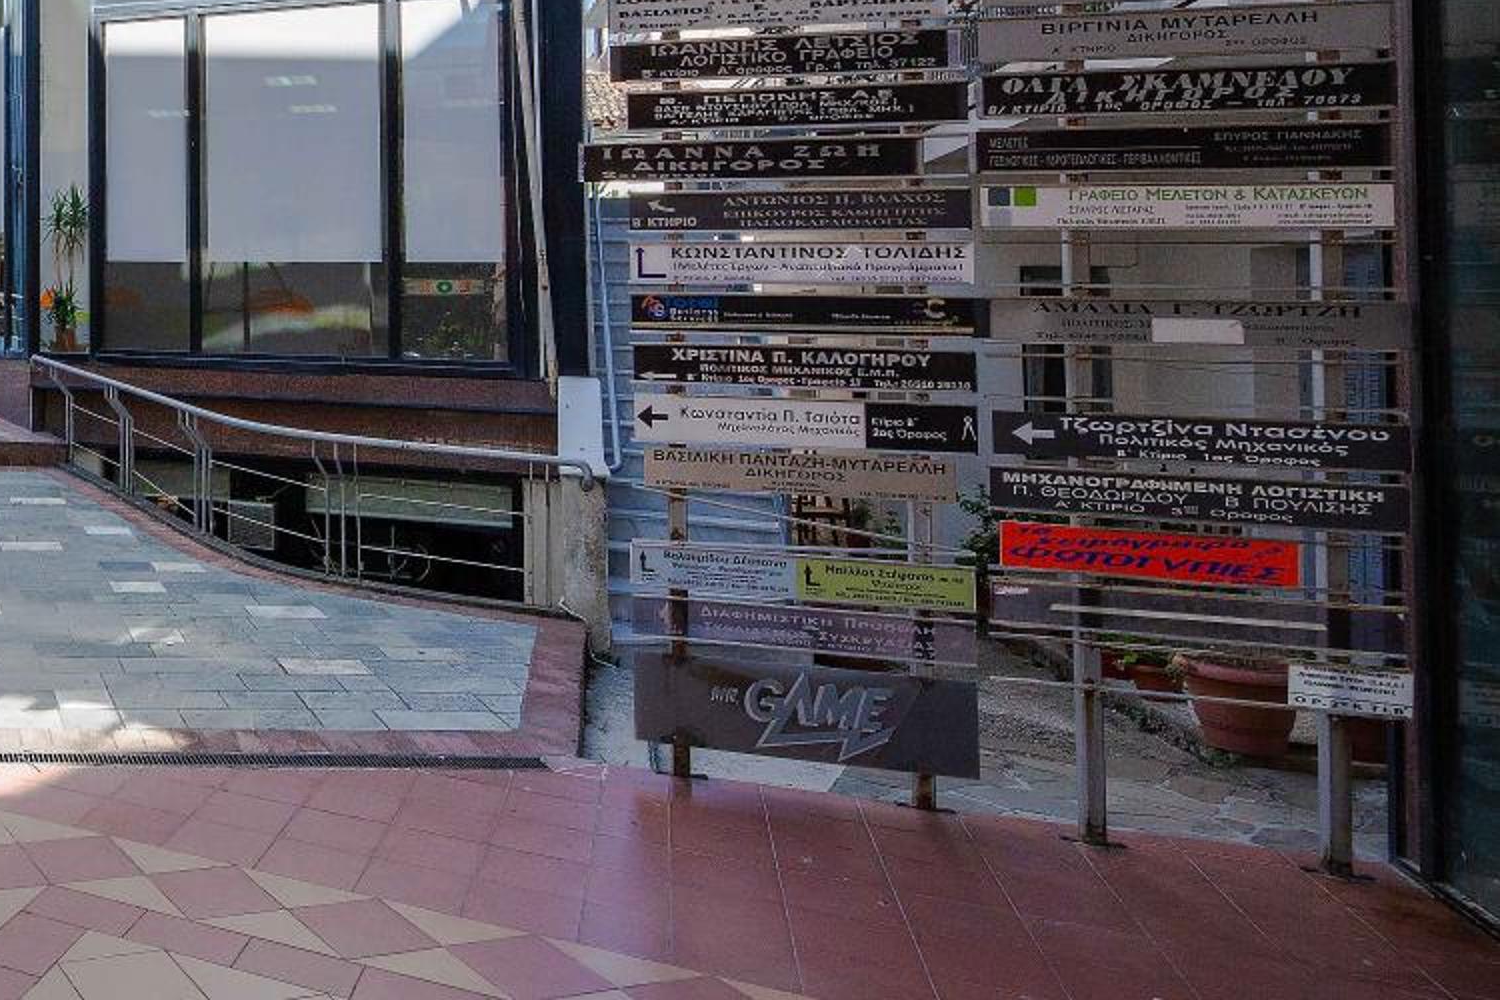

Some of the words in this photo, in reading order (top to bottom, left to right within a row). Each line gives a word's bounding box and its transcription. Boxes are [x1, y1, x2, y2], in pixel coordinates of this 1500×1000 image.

[1041, 18, 1149, 35] ΒΙΡΓΙΝΙΑ
[1161, 11, 1318, 30] ΜΥΤΑΡΕΛΛΗ
[650, 40, 779, 57] ΙΩΑΝΝΗΣ
[794, 31, 919, 50] ΛΕΤΣΙΟΣ
[1127, 30, 1228, 42] ΔΙΚΗΓΟΡΟΣ
[679, 51, 787, 67] ΛΟΓΙΣΤΙΚΟ
[800, 45, 893, 61] ΓΡΑΦΕΙΟ
[703, 91, 837, 103] ΠΕΠΩΝΗΣ
[1045, 86, 1296, 104] ΔΙΚΗΓΟΡΟΣ
[601, 145, 765, 160] ΙΩΑΝΝΑ
[793, 143, 881, 157] ΖΩΗ
[633, 159, 825, 171] ΔΙΚΗΓΟΡΟΣ
[723, 193, 829, 206] ΑΝΤΩΝΙΟΣ
[860, 192, 947, 203] ΒΛΑΧΟΣ
[1068, 188, 1139, 201] ΓΡΑΦΕΙΟ
[1233, 189, 1246, 201] &
[647, 217, 697, 228] ΚΤΗΡΙΟ
[671, 246, 847, 259] ΚΩΝΣΤΑΝΤΙΝΟΣ
[671, 347, 764, 363] ΧΡΙΣΤΙΝΑ
[771, 351, 793, 363] Π.
[801, 350, 932, 367] ΚΑΛΟΓΗΡΟΥ
[699, 363, 768, 374] ΠΟΛΙΤΙΚΟΣ
[771, 366, 854, 377] ΜΗΧΑΝΙΚΟΣ
[679, 405, 777, 422] Κωνσταντία
[783, 409, 800, 423] Π.
[804, 411, 861, 425] Τσιότα
[871, 428, 895, 439] 2ος
[1059, 416, 1214, 437] Τζωρτζίνα
[1225, 422, 1390, 442] Ντασένου
[1099, 433, 1208, 451] Πολιτικός
[1215, 438, 1349, 457] Μηχανικός
[653, 449, 733, 464] ΒΑΣΙΛΙΚΗ
[739, 453, 945, 475] ΠΑΝΤΑΖΗ-ΜΥΤΑΡΕΛΛΗ
[1139, 449, 1188, 460] Κτίριο
[745, 467, 846, 483] ΔΙΚΗΓΟΡΟΣ
[1002, 471, 1244, 496] ΜΗΧΑΝΟΓΡΑΦΗΜΕΝΗ
[1251, 485, 1385, 503] ΛΟΓΙΣΤΙΚΗ
[1012, 484, 1034, 497] Π.
[1041, 485, 1188, 506] ΘΕΟΔΩΡΙΔΟΥ
[1253, 497, 1373, 516] ΠΟΥΛΙΣΗΣ
[1081, 500, 1145, 513] ΚΤΙΡΙΟ
[699, 604, 833, 628] ΔΙΑΦΗΜΙΣΤΙΚΗ
[744, 670, 892, 740] GAME
